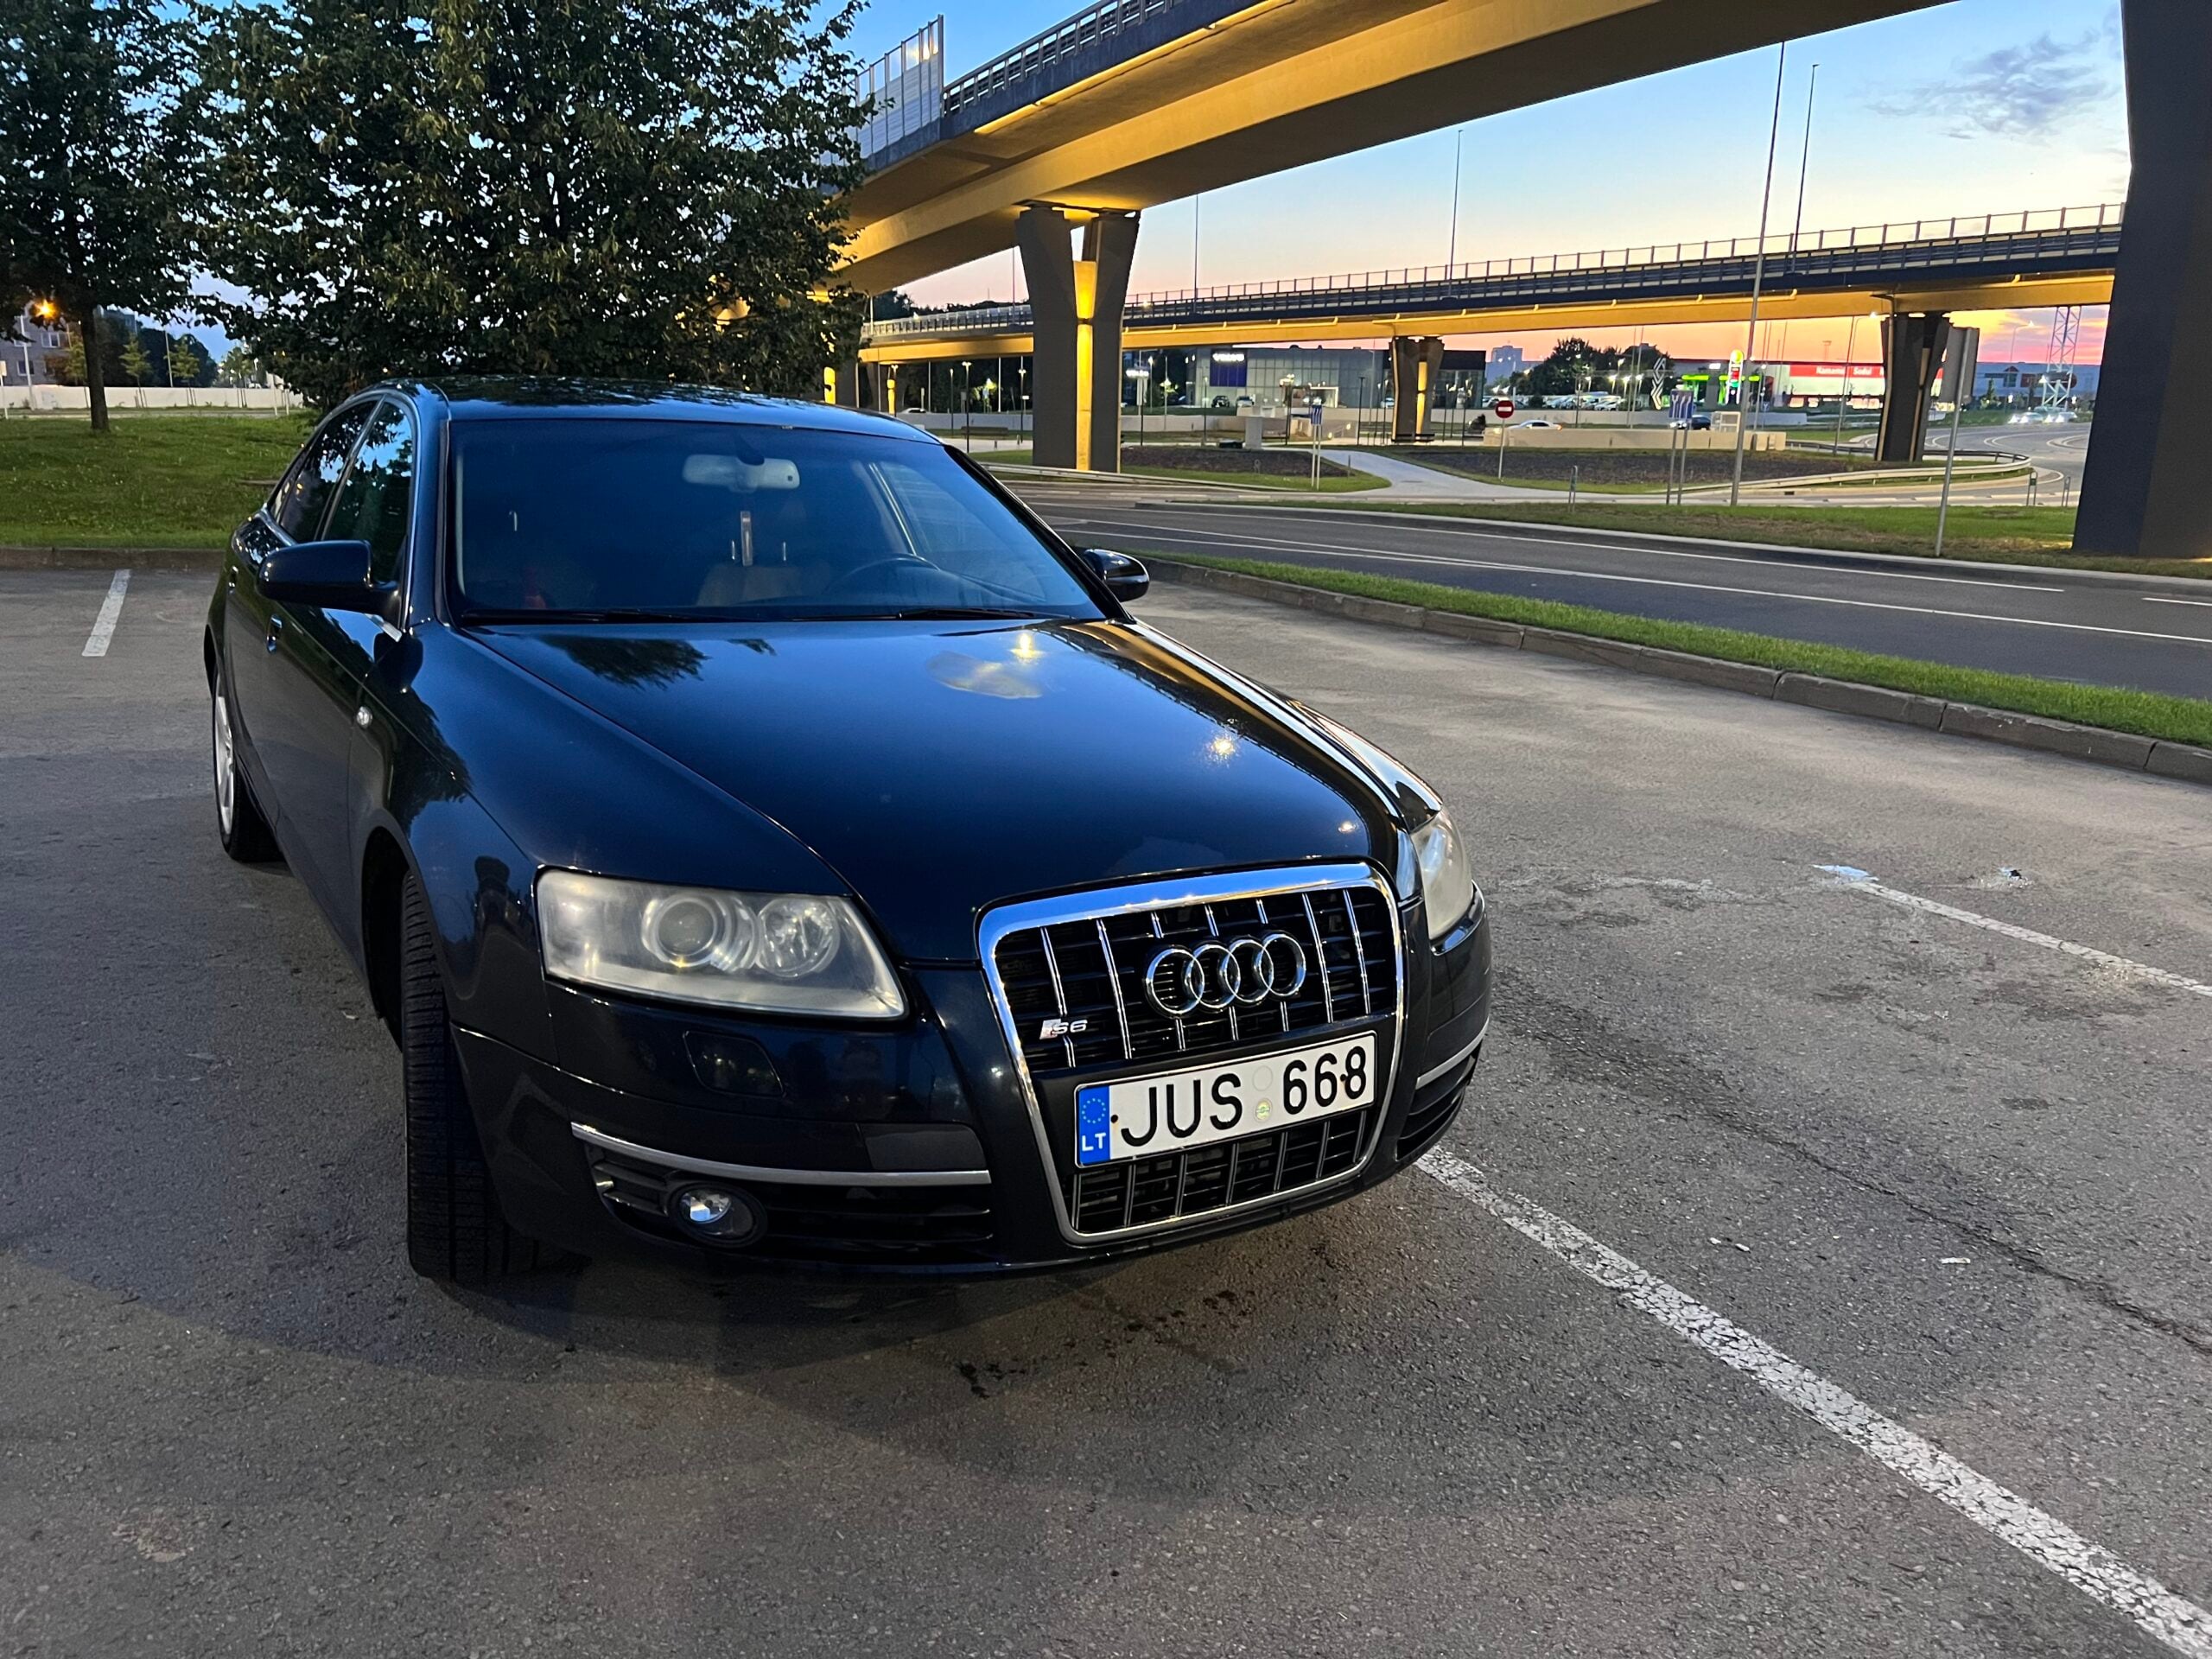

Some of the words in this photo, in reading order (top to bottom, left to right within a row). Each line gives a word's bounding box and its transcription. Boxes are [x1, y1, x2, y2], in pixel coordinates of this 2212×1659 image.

[1051, 1020, 1088, 1034] S6
[1121, 1073, 1243, 1147] JUS
[1283, 1046, 1367, 1116] 668
[1082, 1132, 1106, 1152] LT
